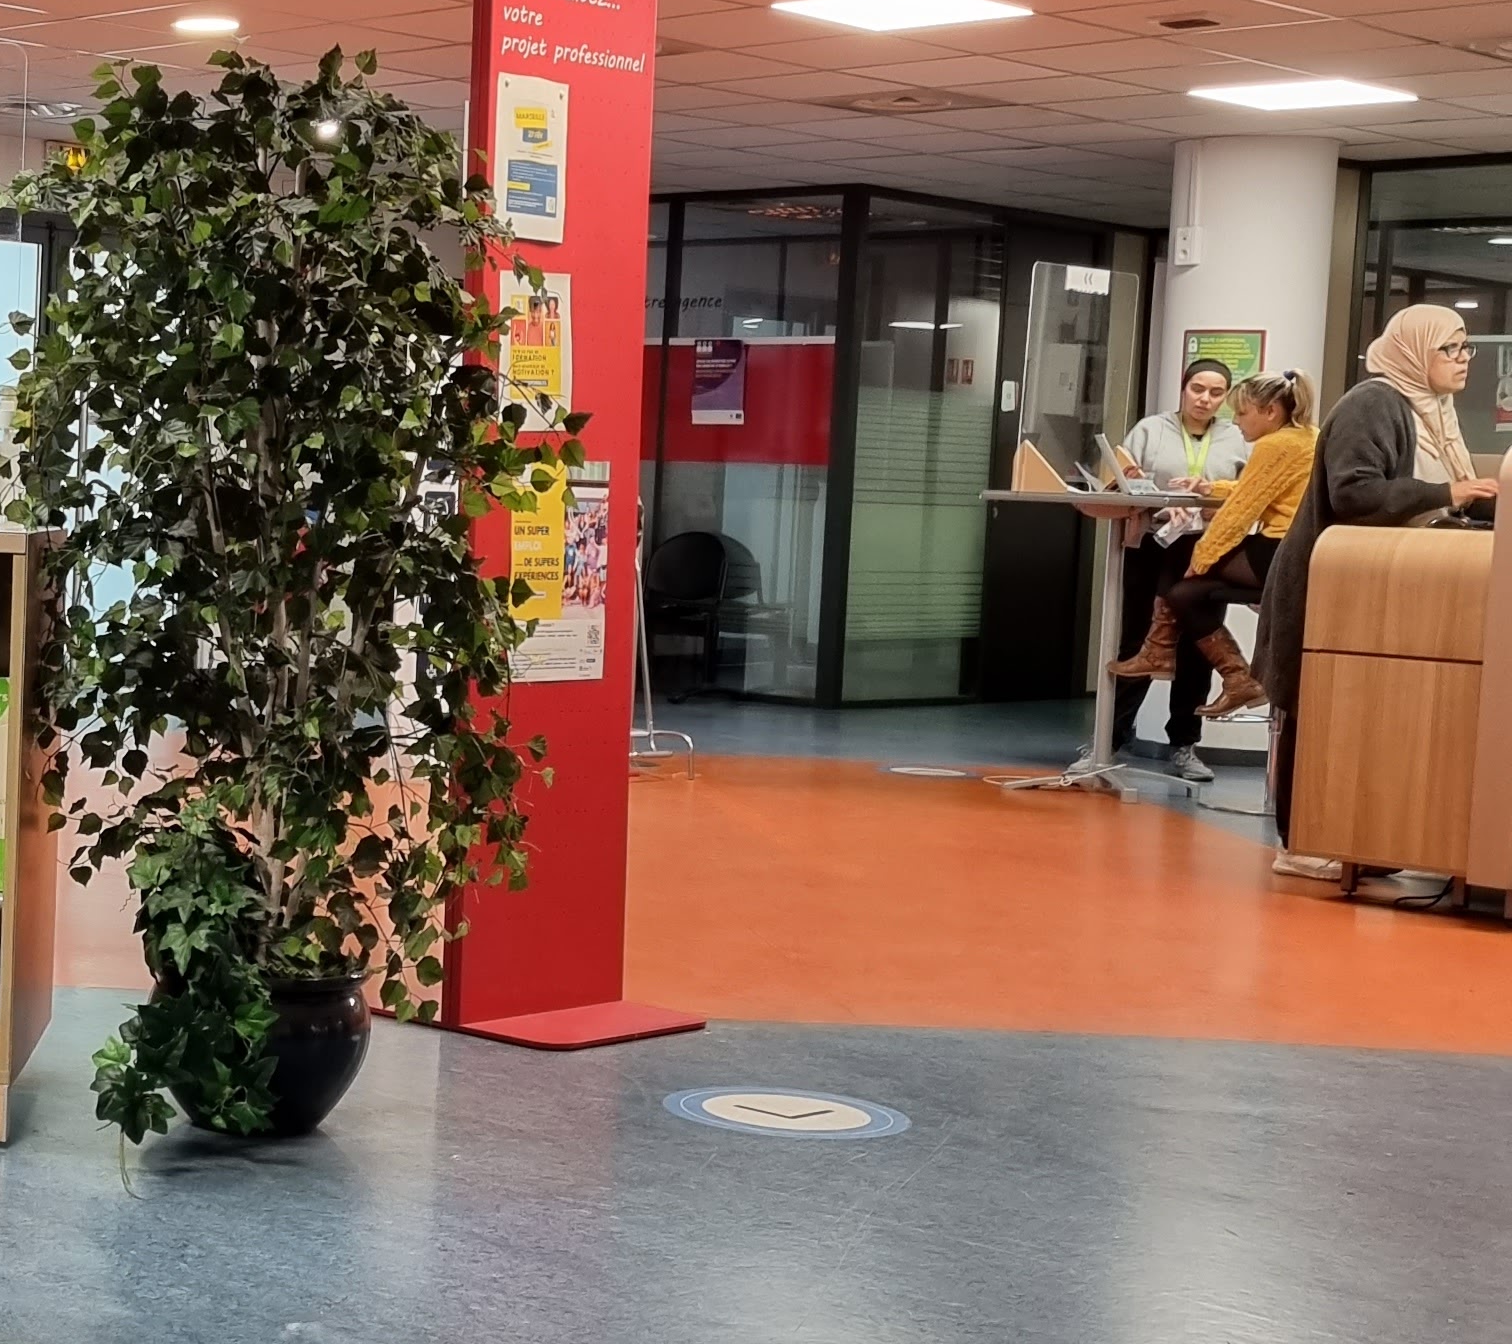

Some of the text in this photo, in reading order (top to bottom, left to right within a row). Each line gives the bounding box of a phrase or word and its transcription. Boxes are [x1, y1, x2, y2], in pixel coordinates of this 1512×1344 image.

[503, 5, 543, 26] votre
[501, 35, 645, 73] projet professionnel
[514, 526, 549, 535] UN SUPER
[524, 558, 559, 566] DE SUPERS
